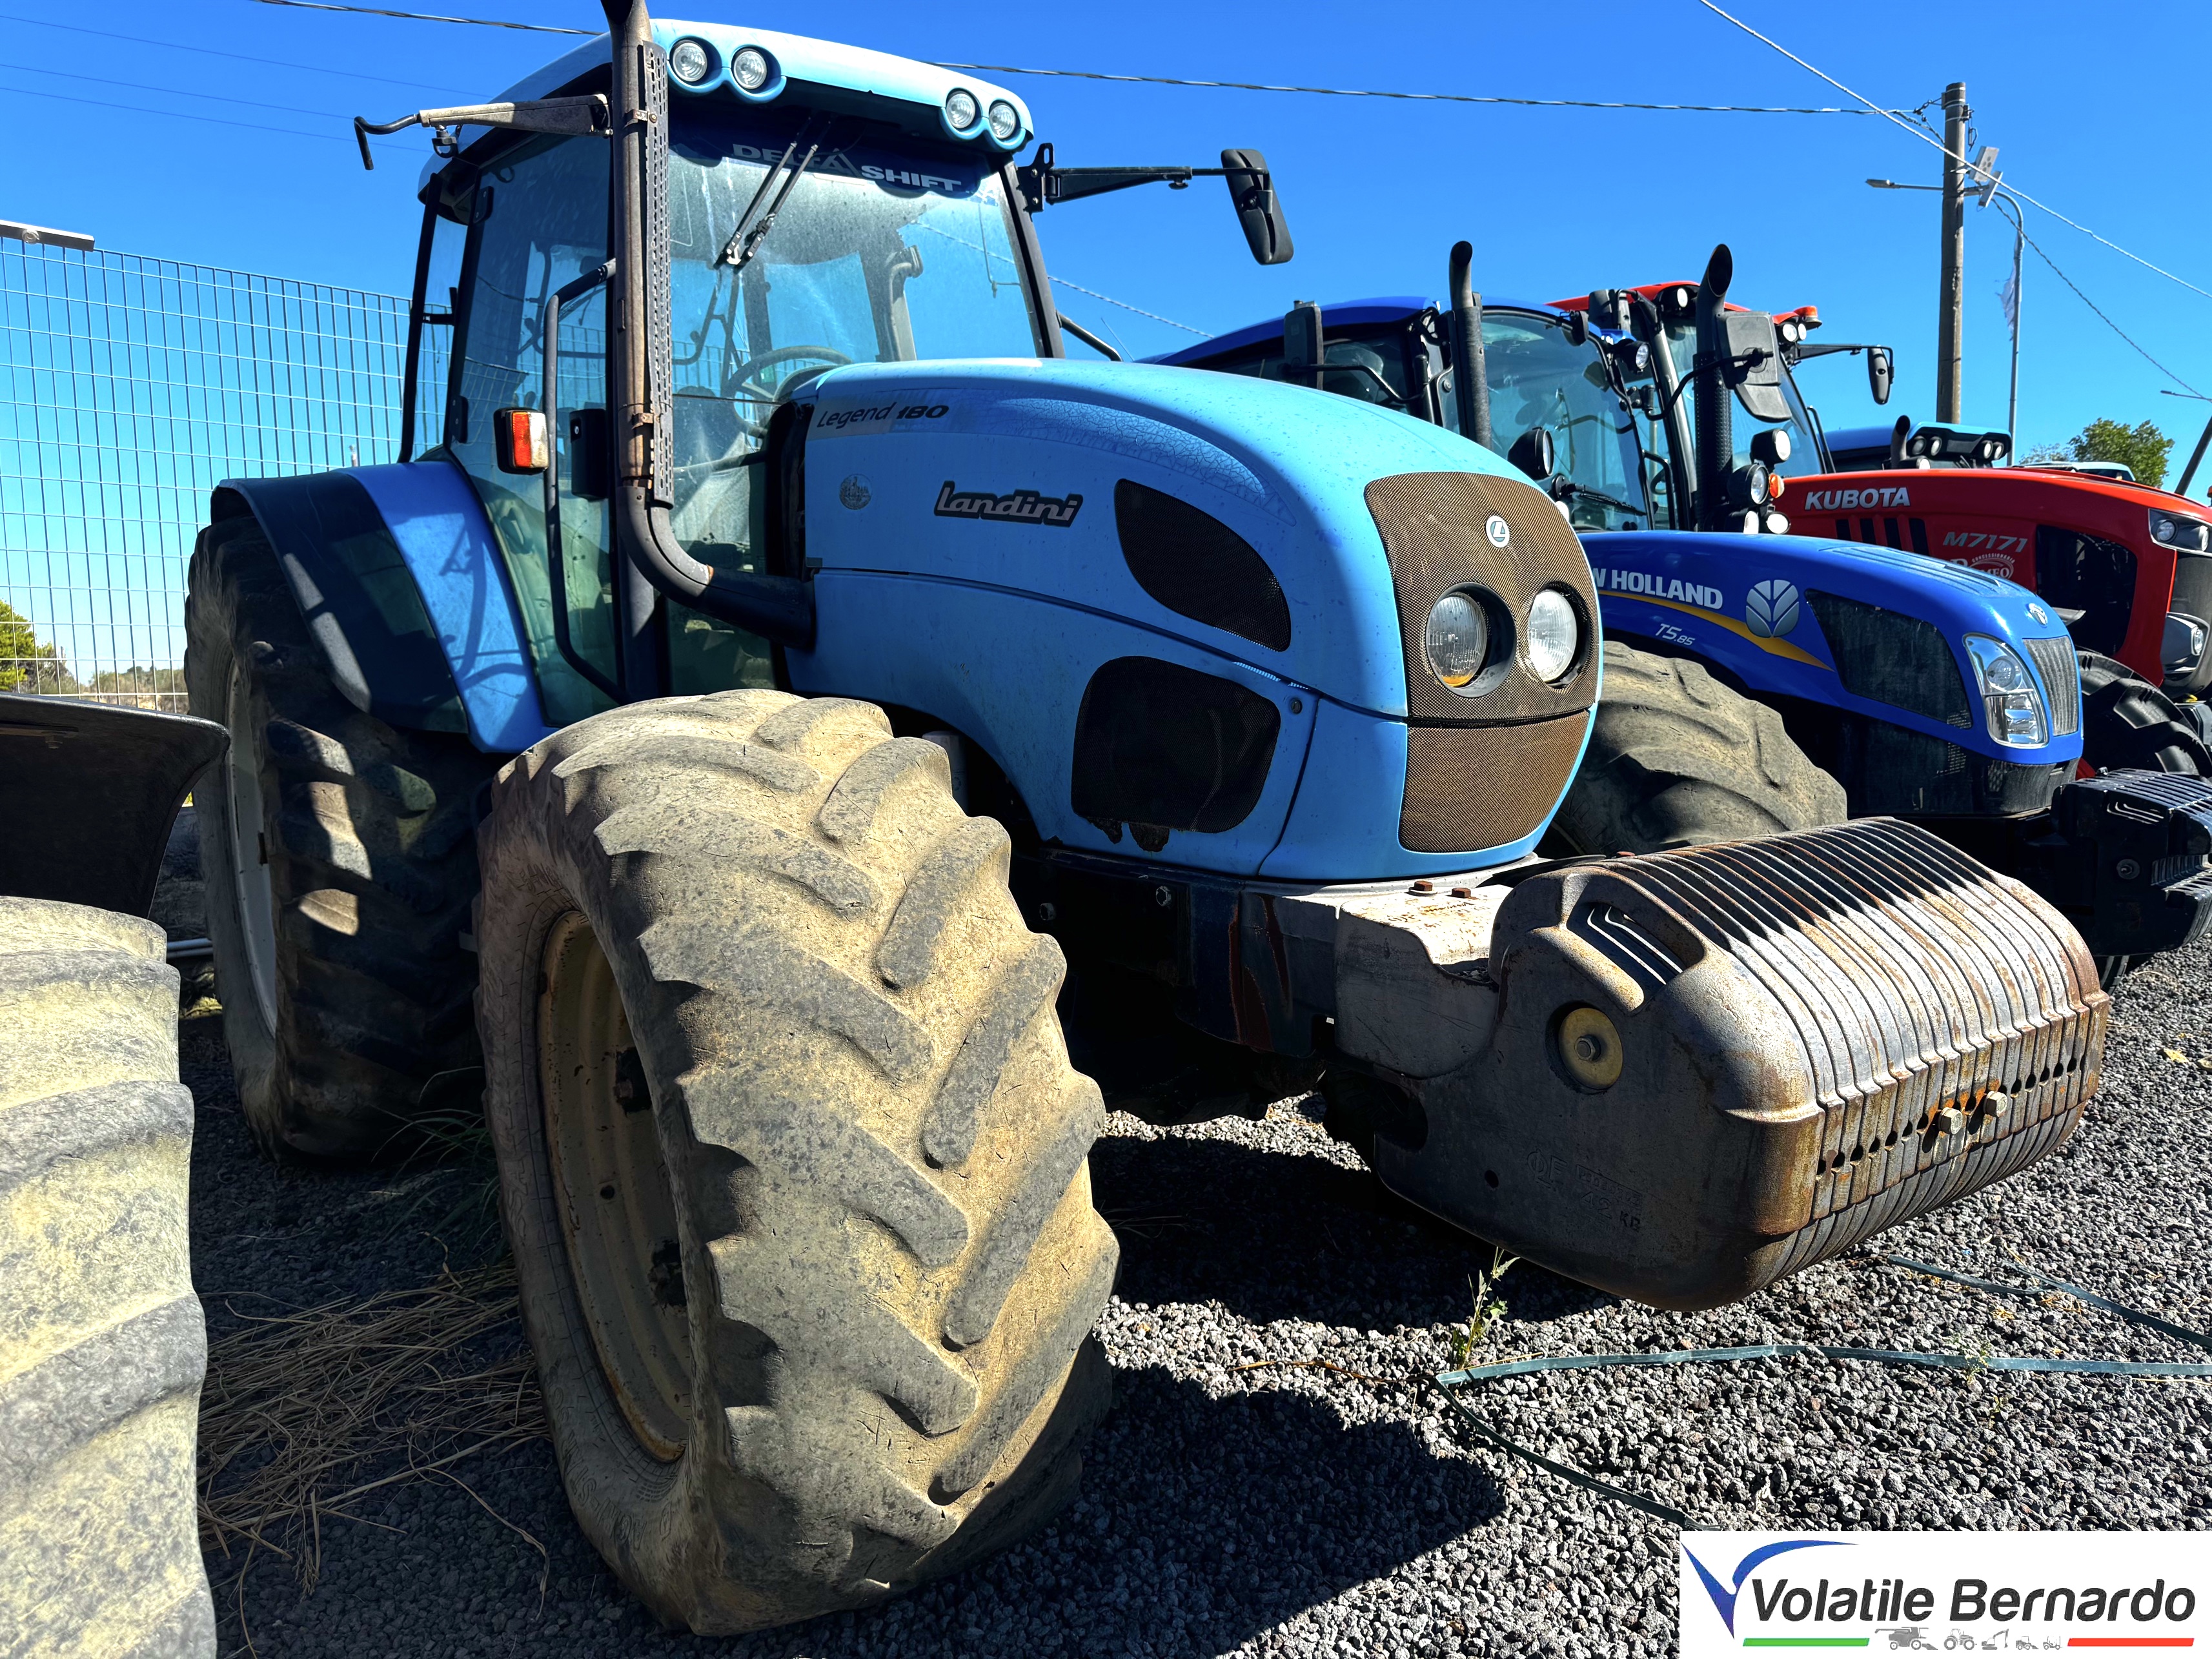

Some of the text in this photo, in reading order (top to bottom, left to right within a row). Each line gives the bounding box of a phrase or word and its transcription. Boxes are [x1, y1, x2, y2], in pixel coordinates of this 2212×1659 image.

[733, 143, 961, 191] DELTA SHIFT
[817, 402, 949, 429] Legend 180
[1805, 487, 1911, 511] KUBOTA
[1943, 531, 2028, 553] M7171
[1611, 569, 1723, 609] HOLLAND
[1655, 623, 1696, 646] T5.85
